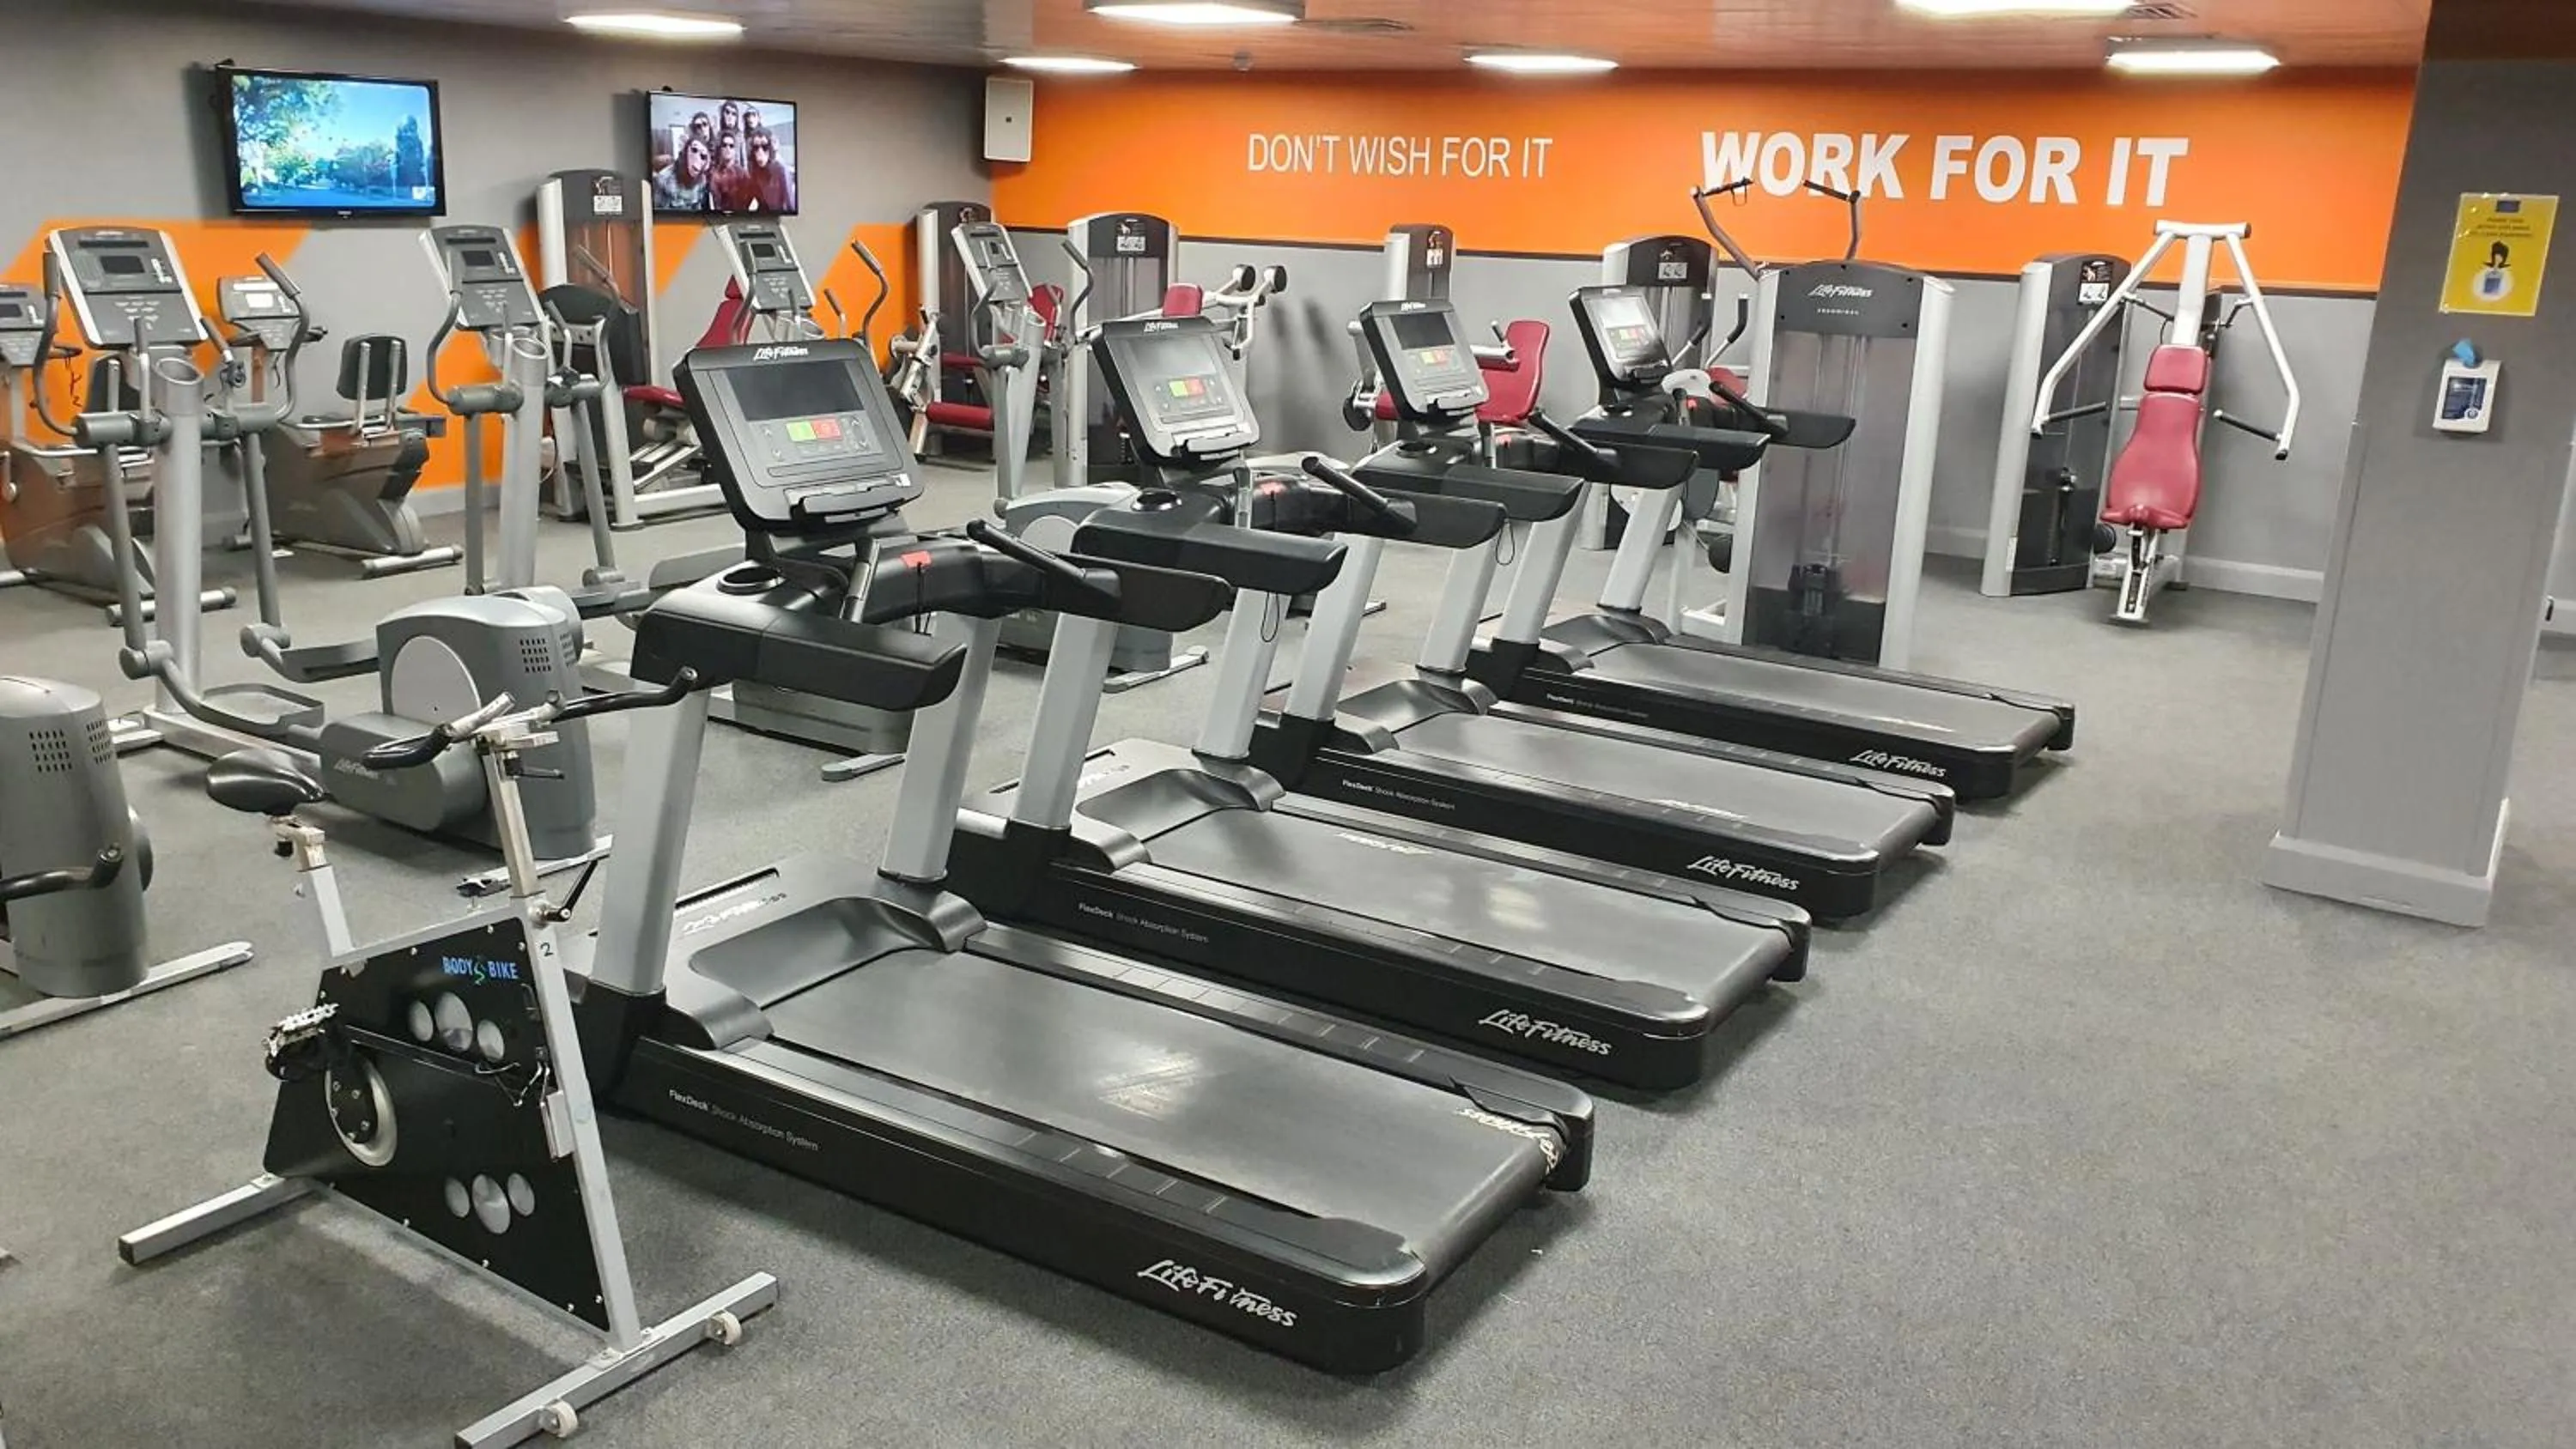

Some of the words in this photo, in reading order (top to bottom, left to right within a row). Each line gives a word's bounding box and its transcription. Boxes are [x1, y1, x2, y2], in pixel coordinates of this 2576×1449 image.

[1248, 134, 1340, 173] DON'T
[1348, 136, 1431, 176] WISH
[1441, 137, 1511, 177] FOR
[1522, 137, 1552, 178] IT
[1700, 130, 1910, 198] WORK
[1929, 135, 2081, 204] FOR
[2106, 136, 2190, 206] IT
[539, 942, 554, 957] 2
[441, 956, 473, 976] BODY
[487, 961, 519, 979] BIKE
